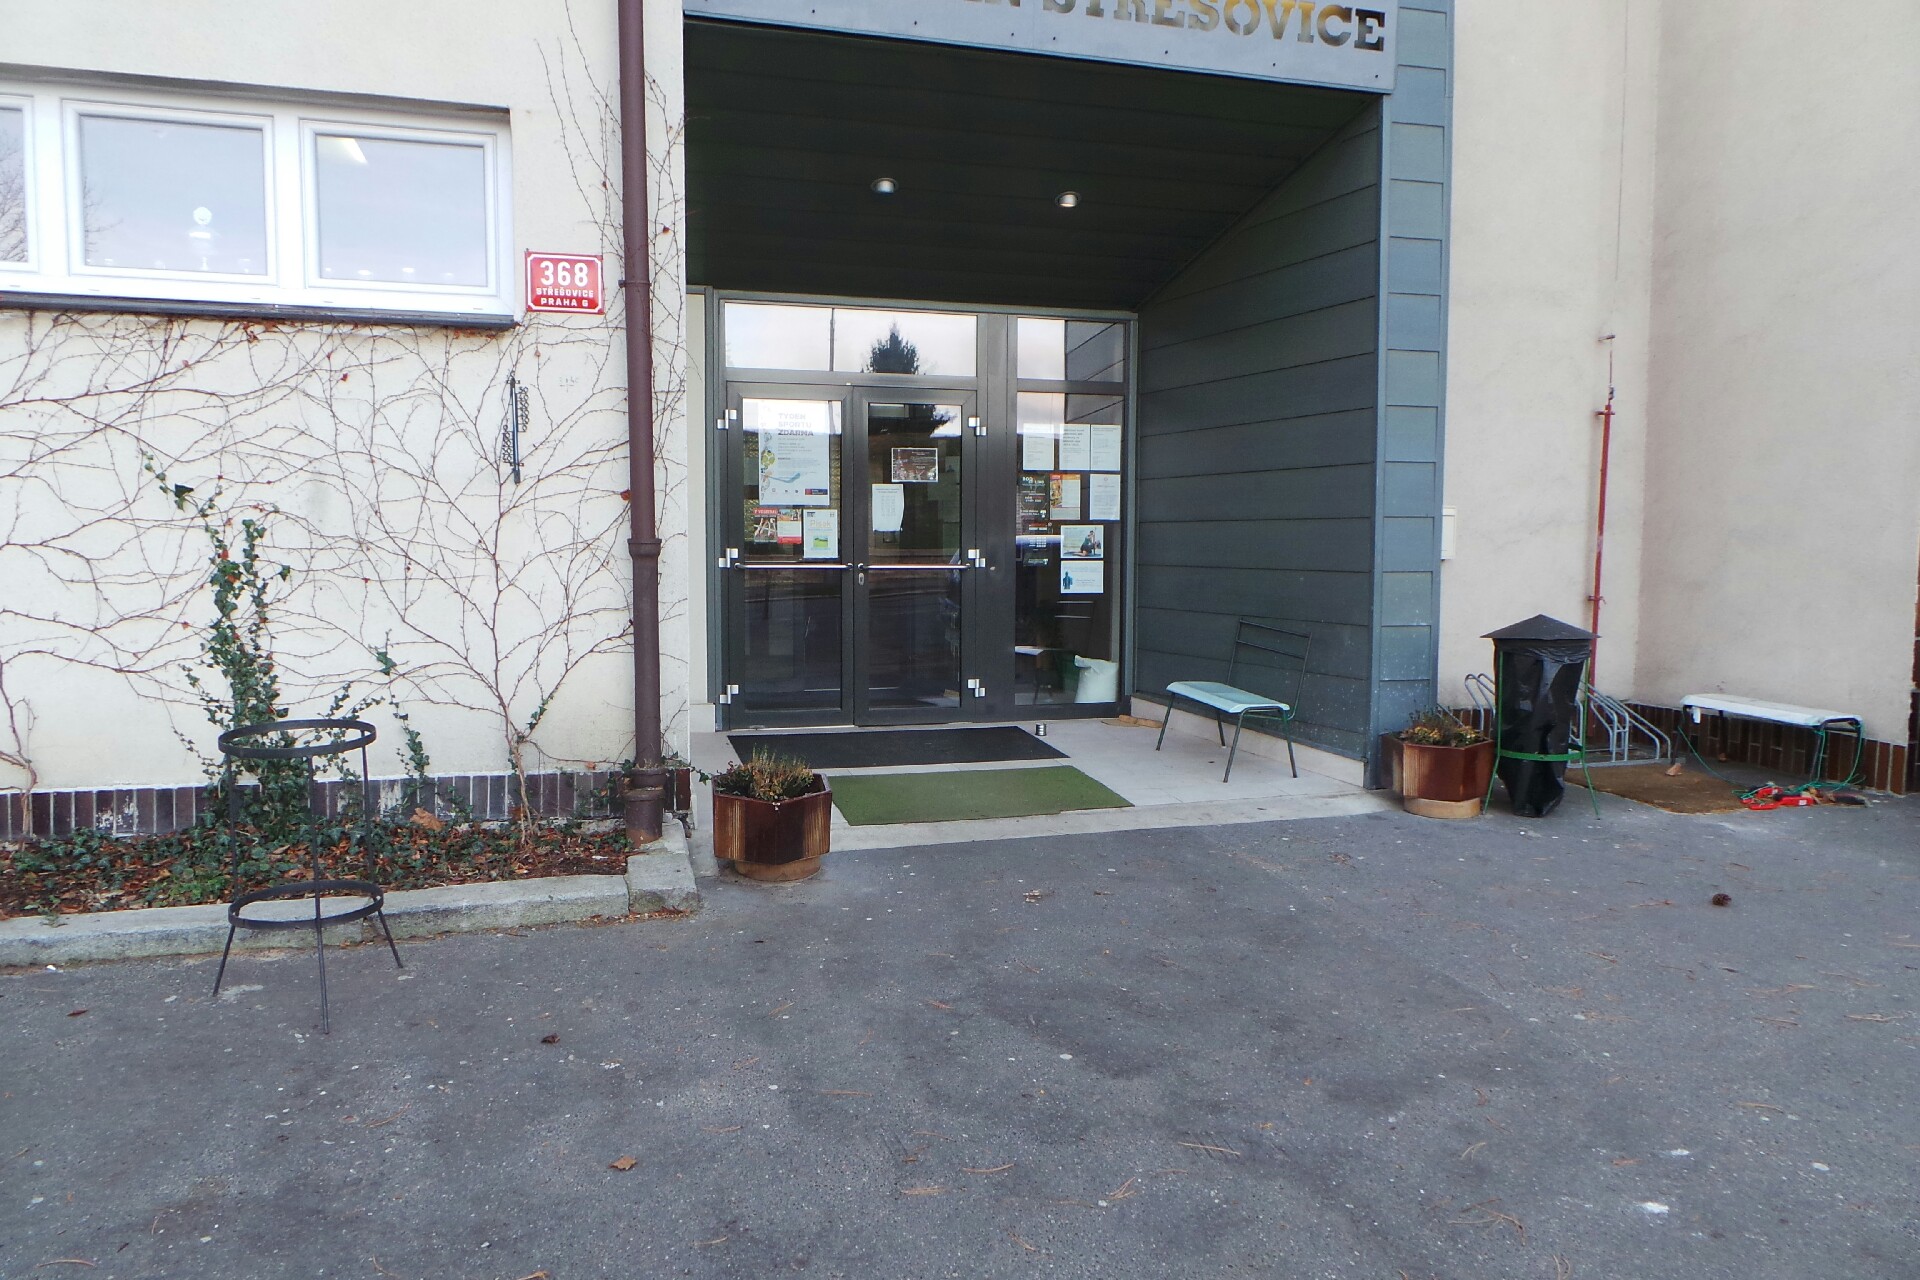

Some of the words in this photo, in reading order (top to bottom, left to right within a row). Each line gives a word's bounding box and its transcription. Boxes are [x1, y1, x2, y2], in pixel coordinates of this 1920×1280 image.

[540, 260, 588, 287] 368
[536, 286, 594, 298] STŘEŠOVICE
[540, 297, 577, 307] PRAHA
[582, 299, 589, 307] 6
